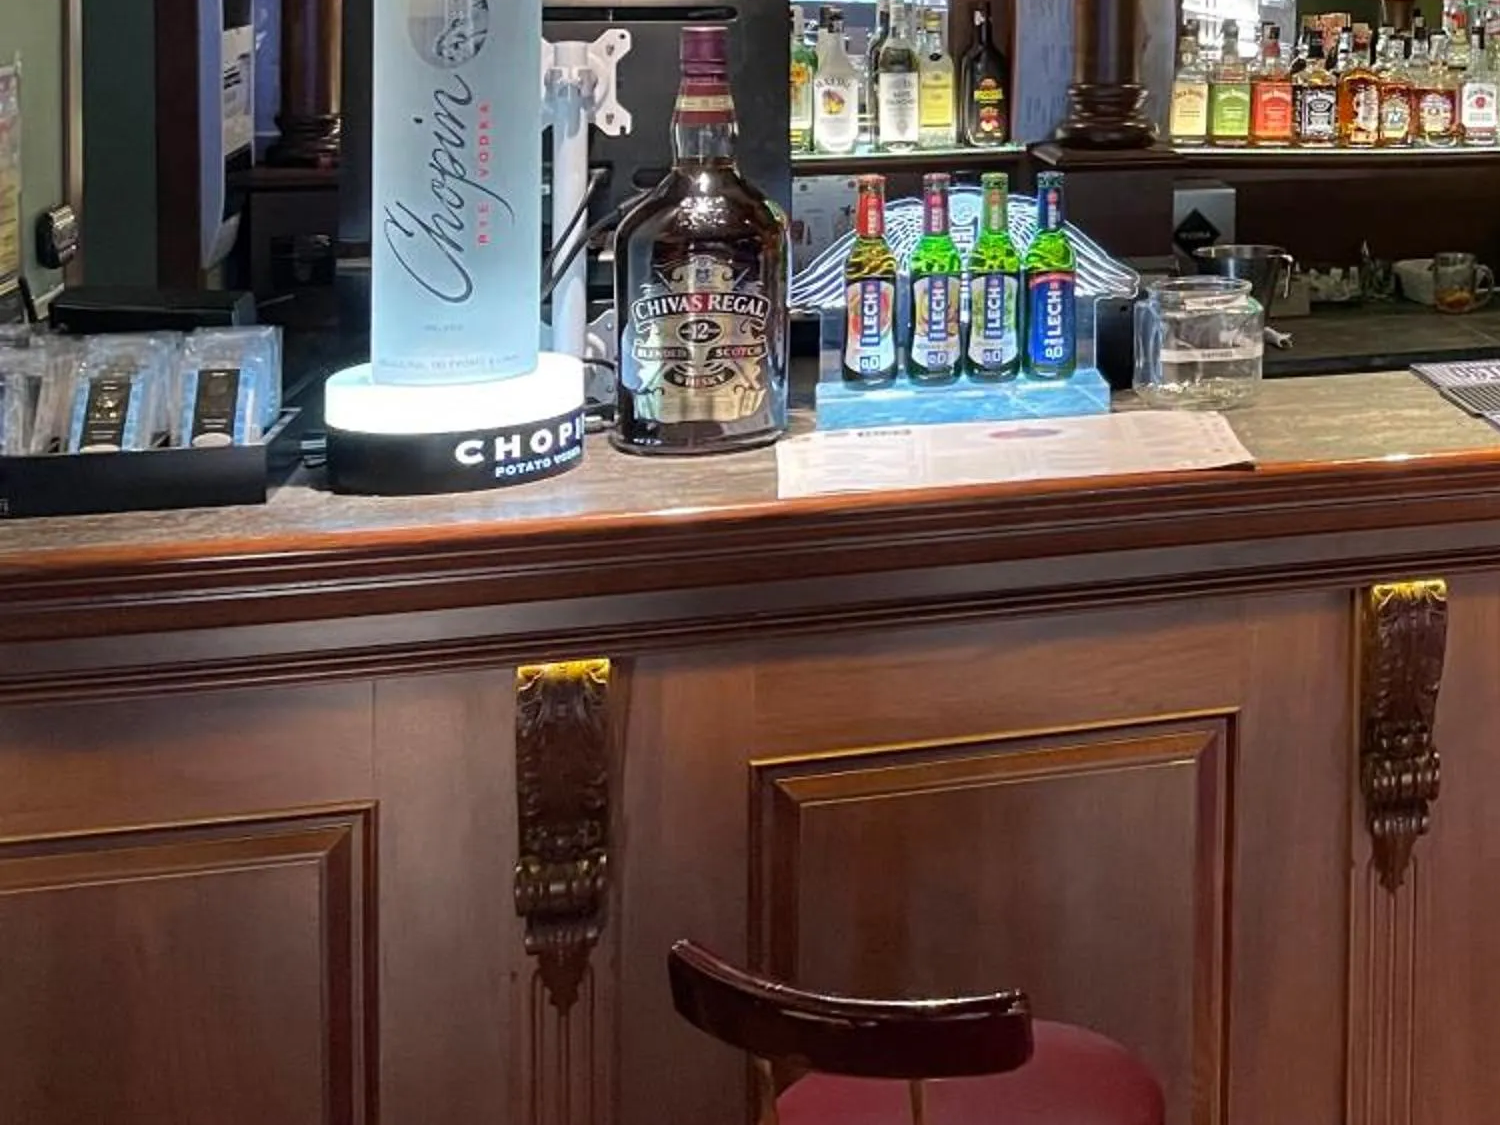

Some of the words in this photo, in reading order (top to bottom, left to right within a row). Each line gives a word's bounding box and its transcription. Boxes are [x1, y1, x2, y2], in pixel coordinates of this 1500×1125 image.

[478, 101, 491, 179] VODKA
[384, 73, 516, 305] Chopin
[635, 293, 702, 321] CHIVAS
[707, 294, 766, 318] REGAL
[863, 289, 879, 339] LECH
[930, 290, 946, 332] LECH
[987, 287, 1001, 329] LECH
[1047, 291, 1062, 336] LECH
[690, 321, 710, 341] 12
[494, 457, 551, 478] POTATO
